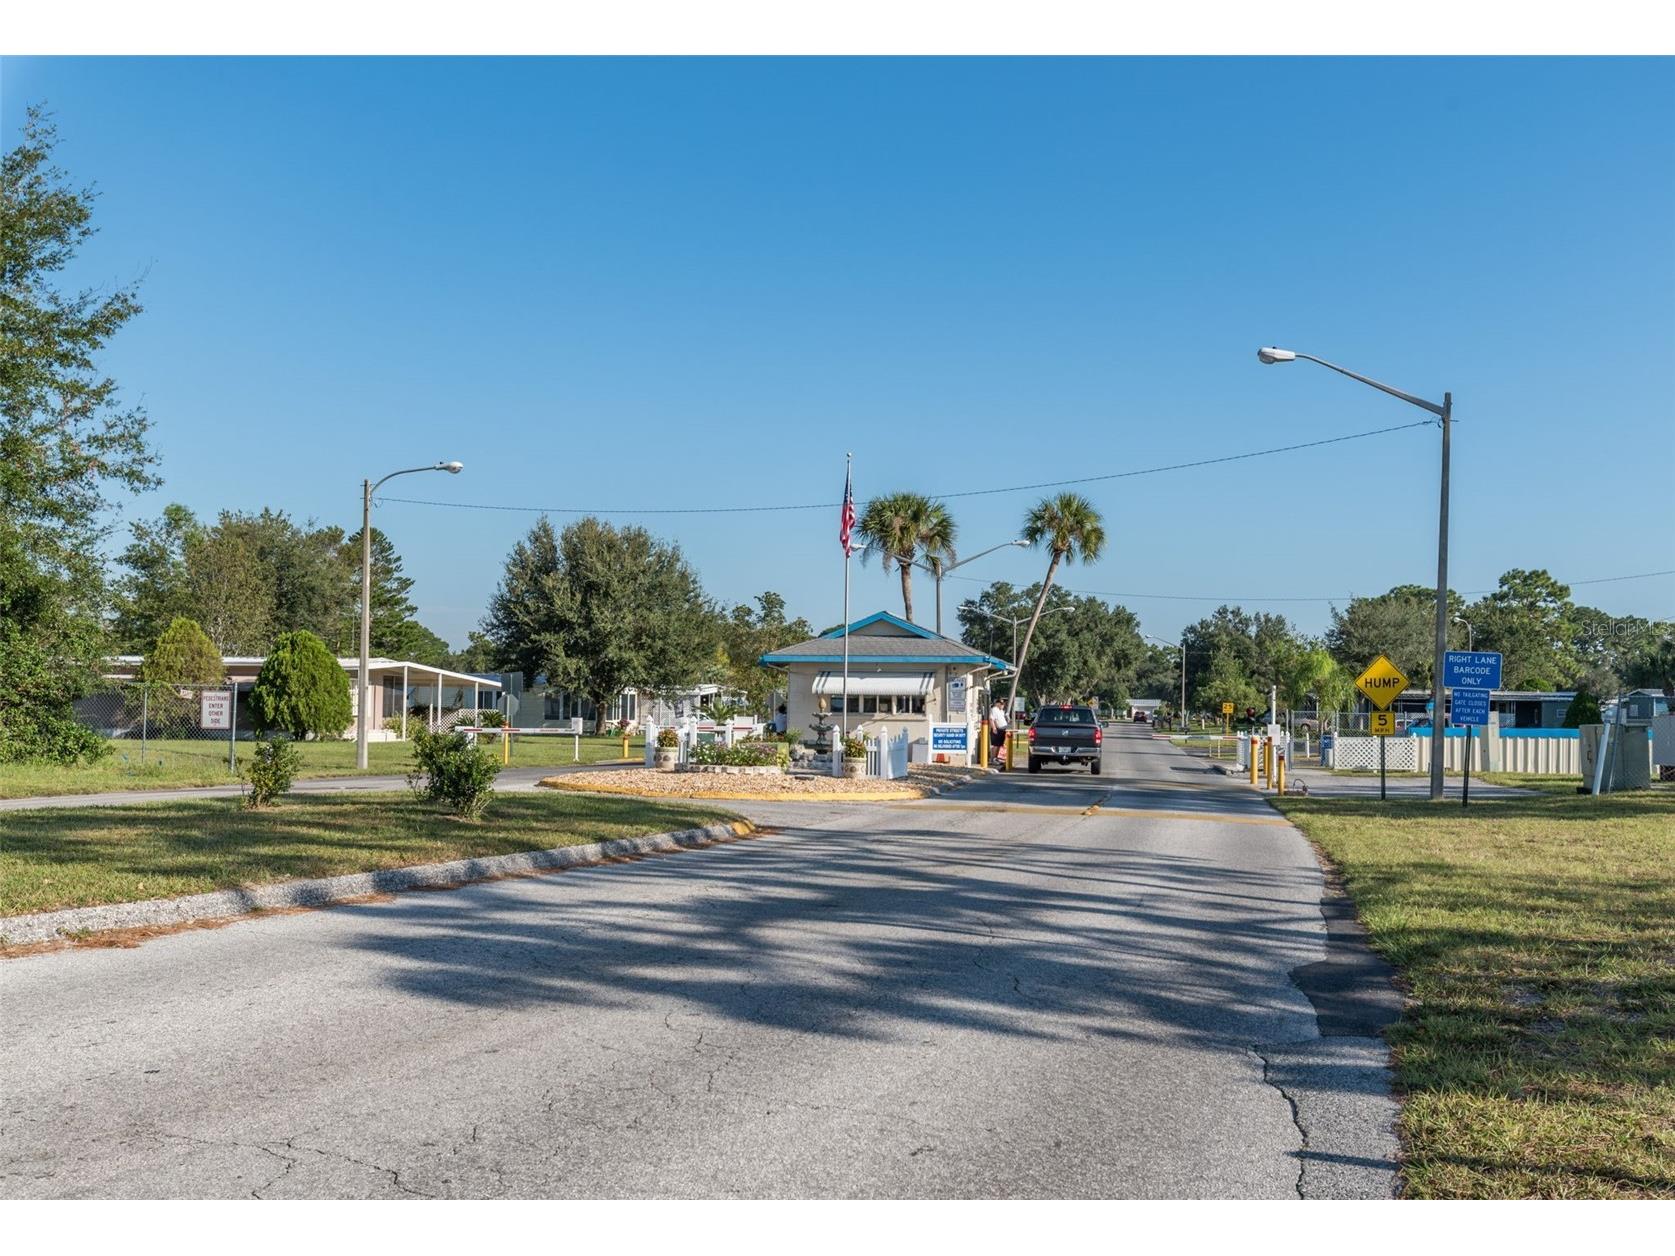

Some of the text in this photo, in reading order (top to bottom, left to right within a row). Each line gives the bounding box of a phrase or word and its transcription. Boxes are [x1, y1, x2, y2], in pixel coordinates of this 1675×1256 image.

[1449, 655, 1497, 664] RIGHT LANE
[1453, 666, 1491, 675] BARCODE
[1365, 677, 1399, 688] HUMP
[1461, 677, 1481, 685] ONLY
[1378, 714, 1387, 726] 5
